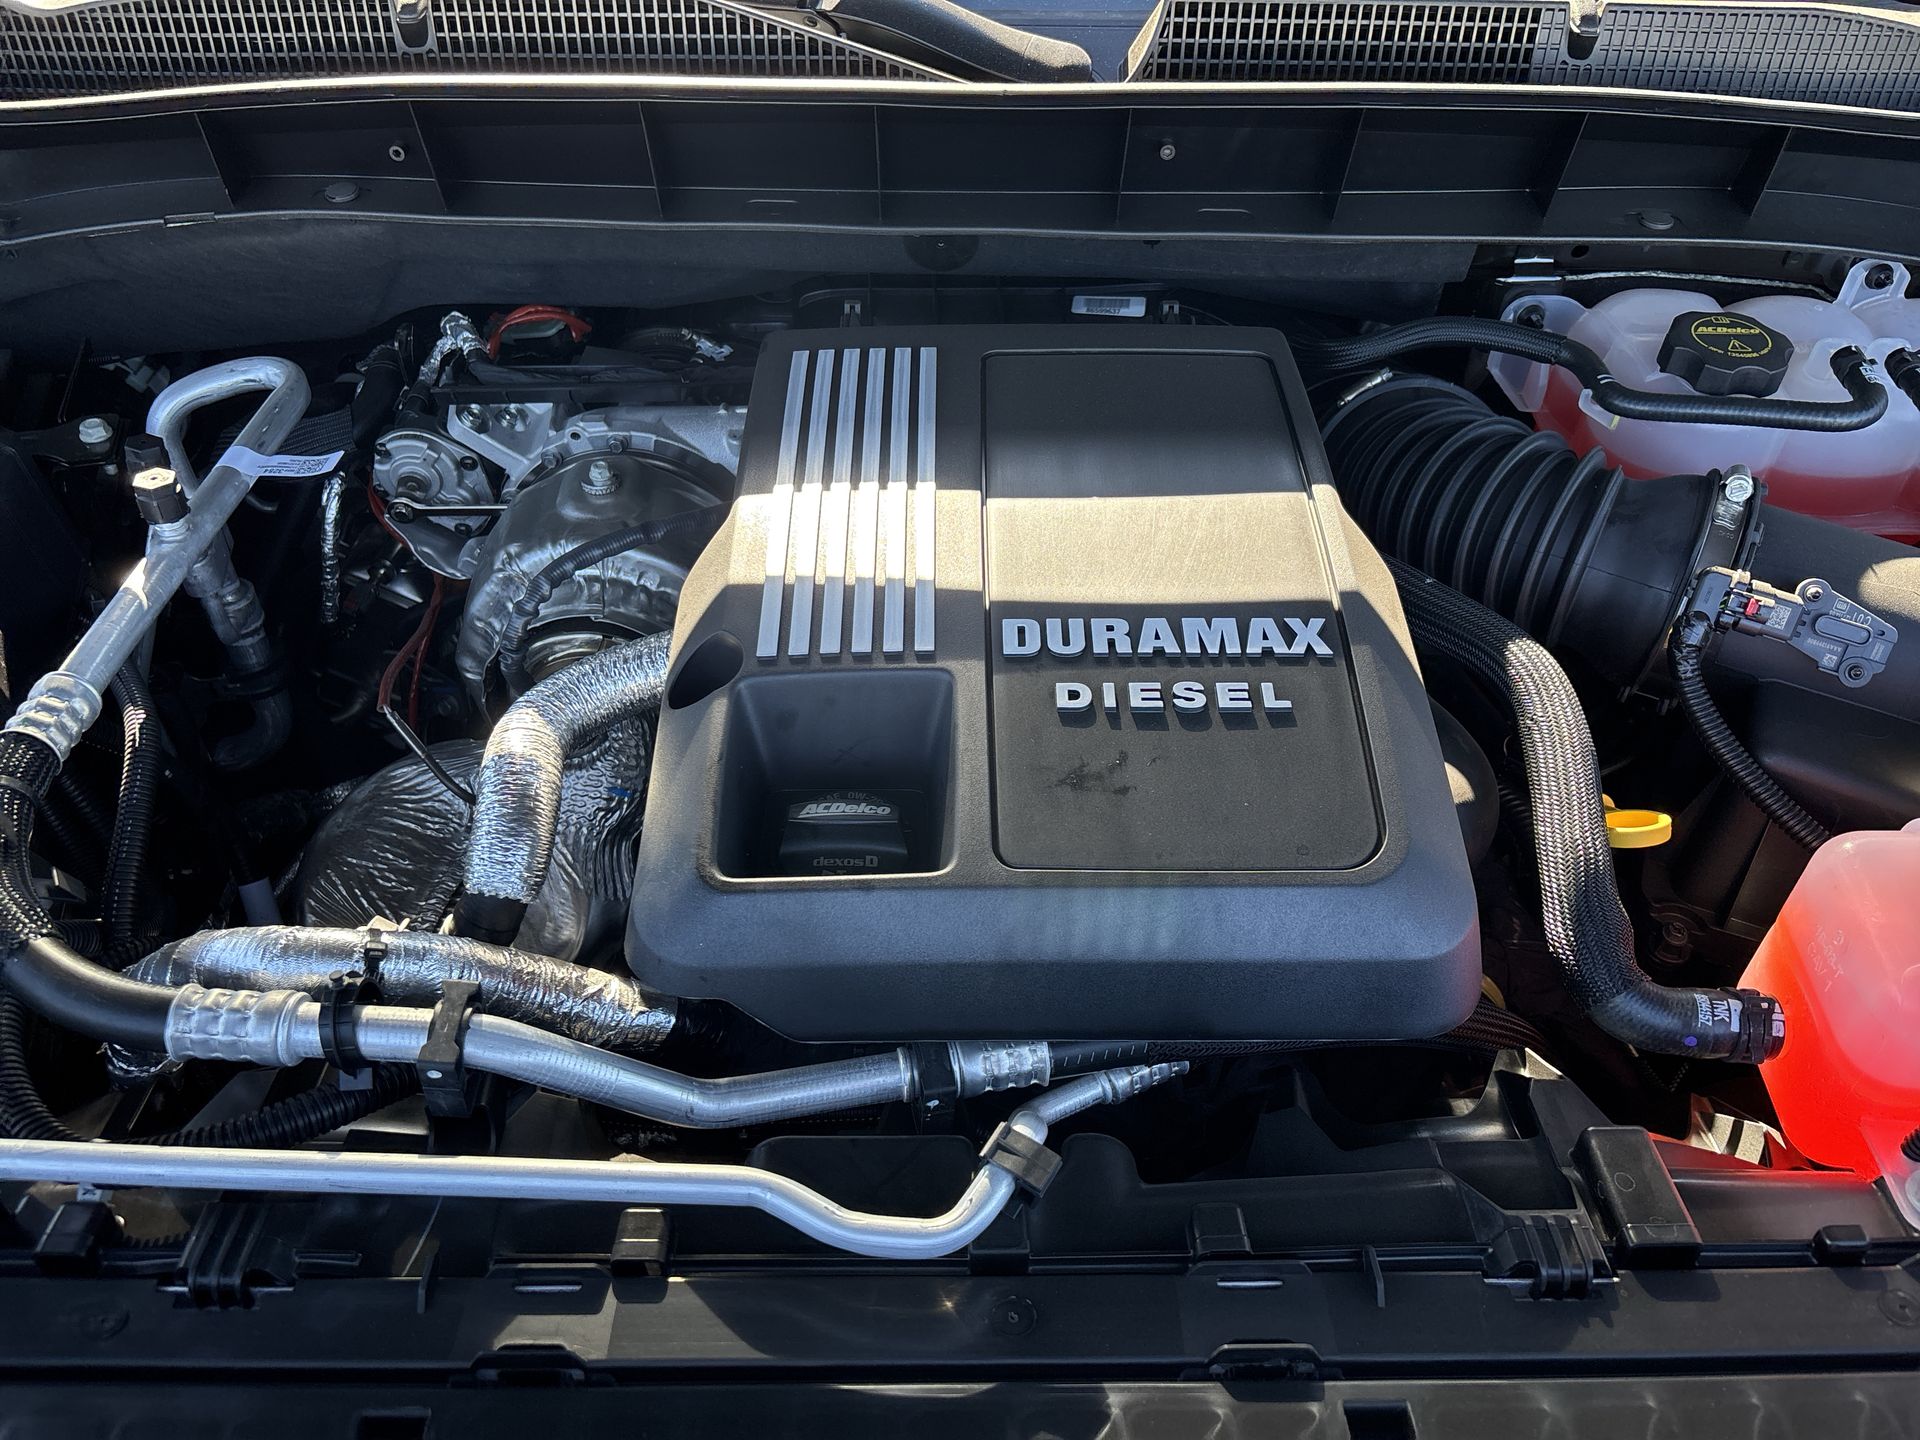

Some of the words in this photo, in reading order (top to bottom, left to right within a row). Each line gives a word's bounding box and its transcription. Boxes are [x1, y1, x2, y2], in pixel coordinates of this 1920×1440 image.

[1696, 326, 1760, 334] ACDelco
[1002, 617, 1334, 658] DURAMAX
[1055, 681, 1293, 713] DIESEL
[800, 802, 892, 815] ACDelco
[1711, 1000, 1730, 1022] TNK
